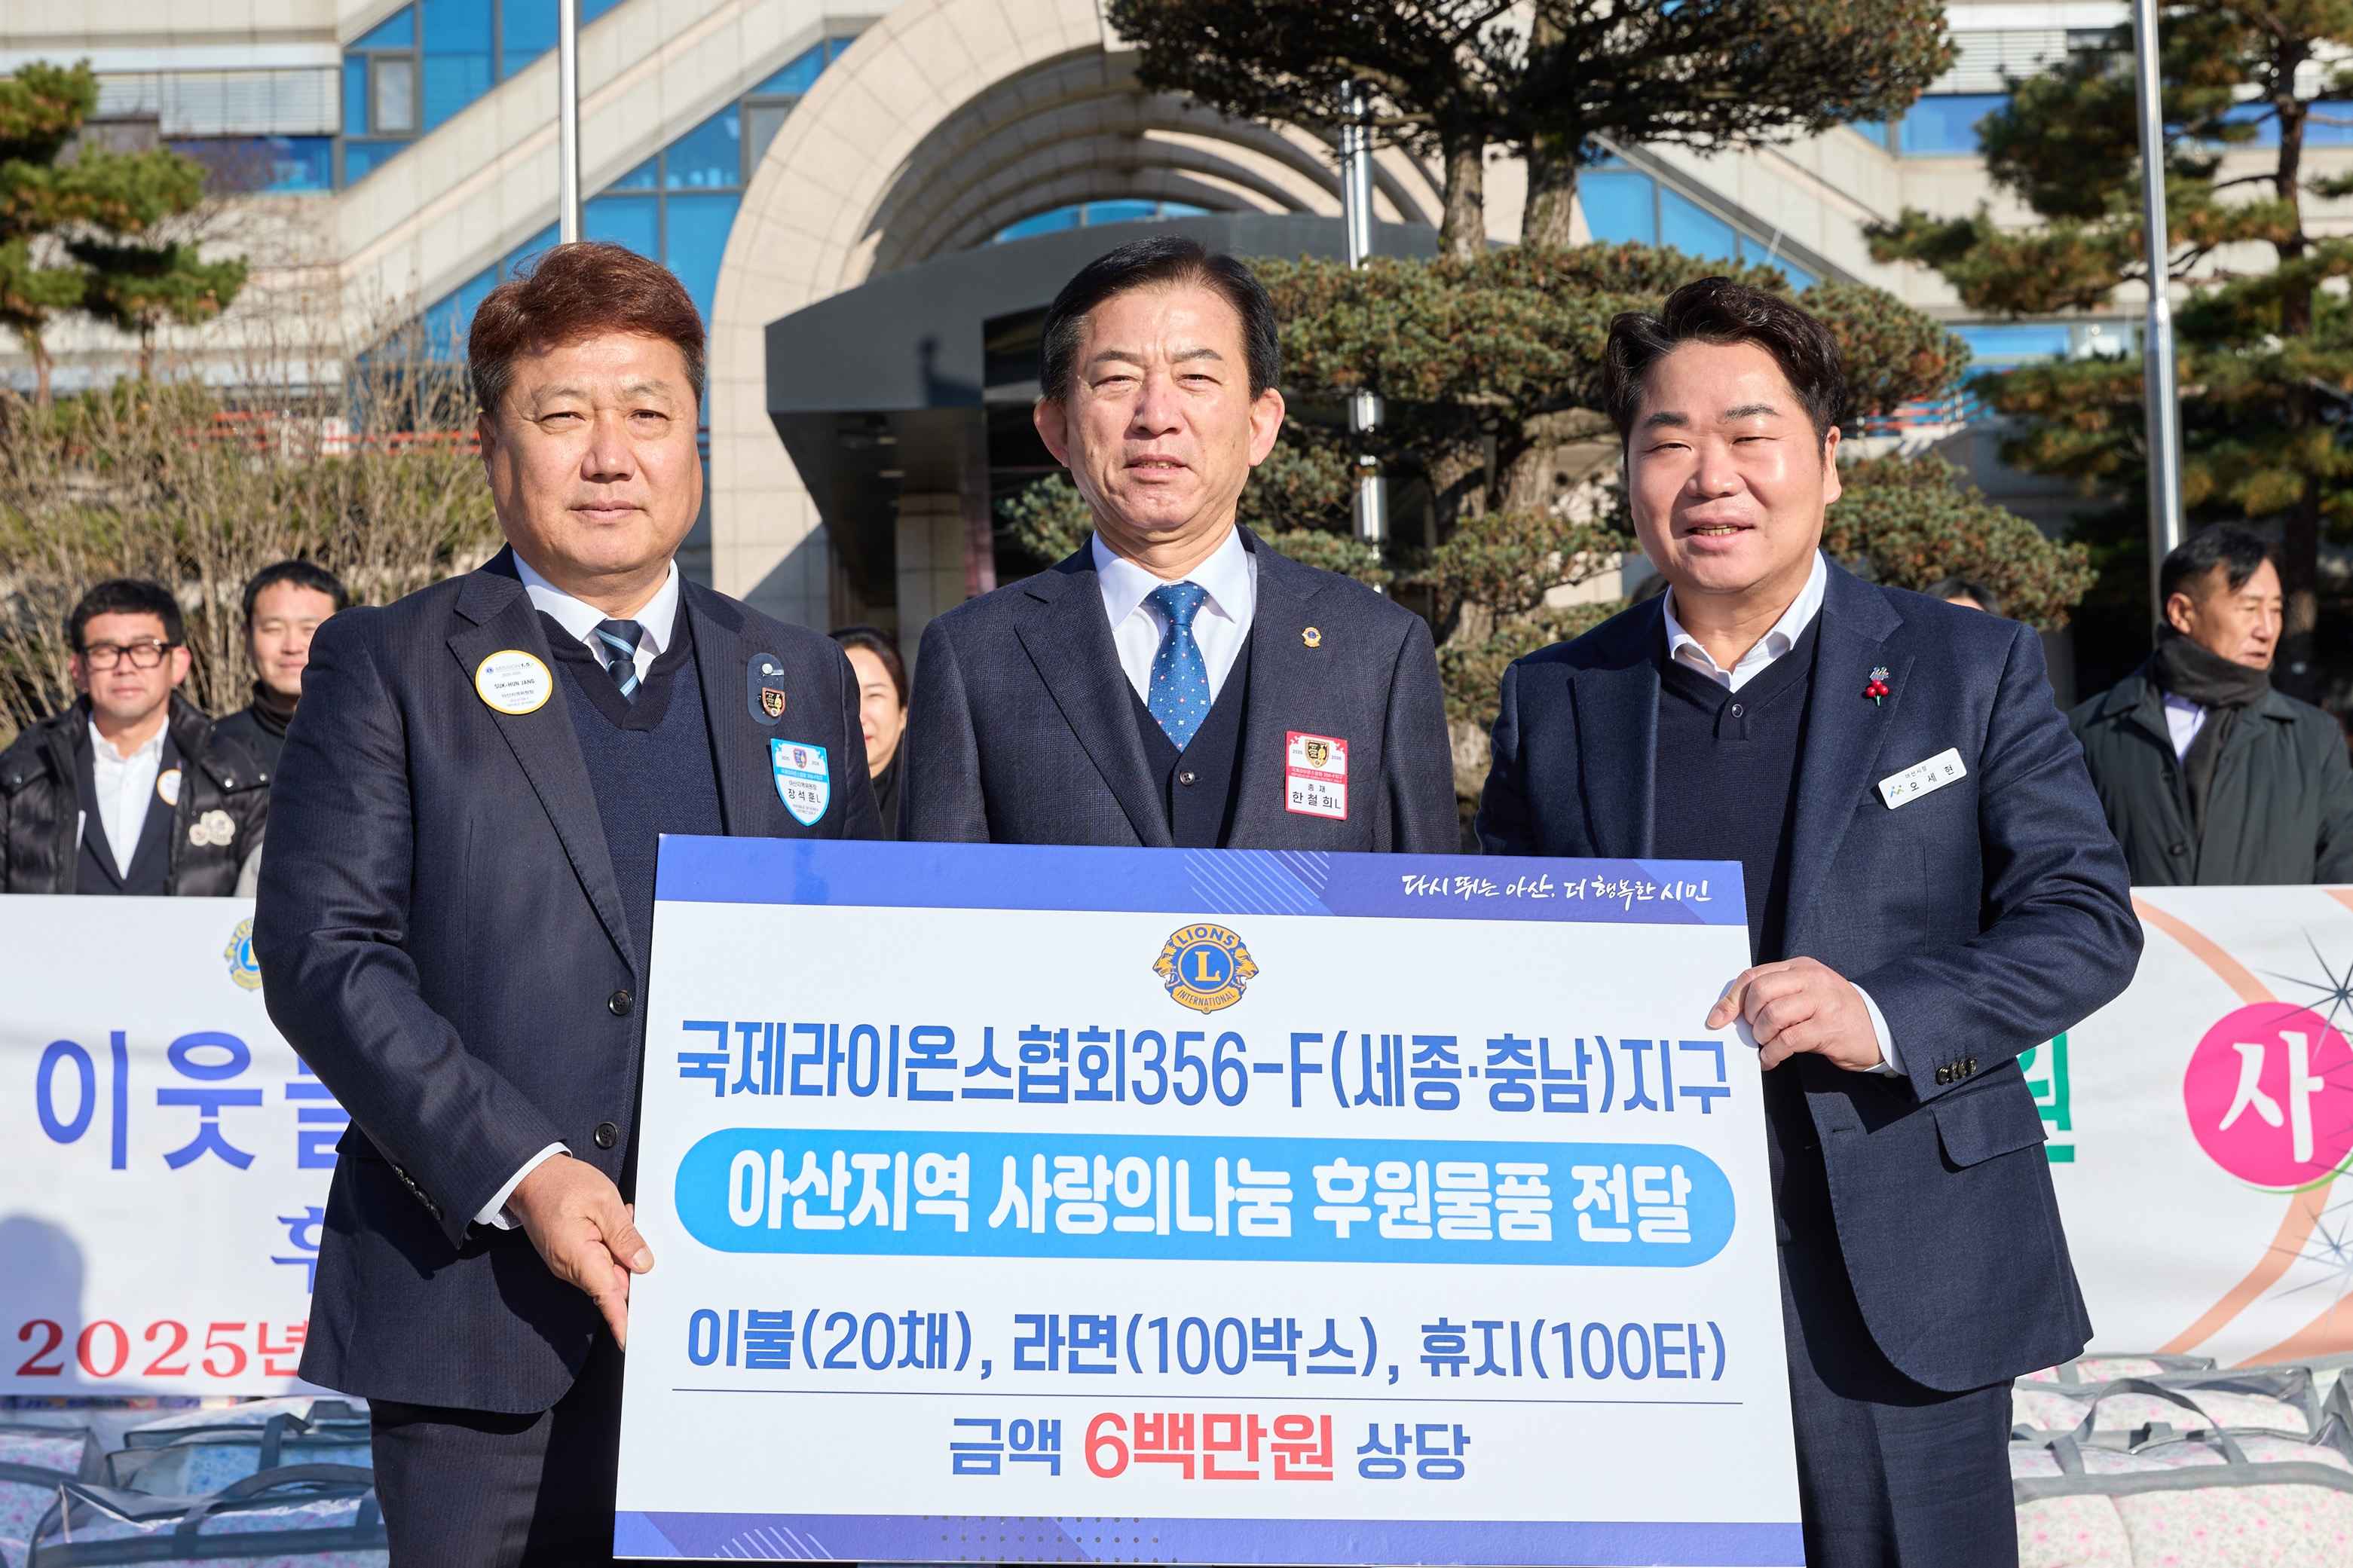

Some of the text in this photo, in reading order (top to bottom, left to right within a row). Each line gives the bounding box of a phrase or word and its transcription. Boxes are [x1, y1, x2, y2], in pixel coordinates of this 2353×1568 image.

[1402, 875, 1447, 896] 다시
[1455, 876, 1500, 900] 뛰는
[1564, 879, 1586, 900] 더
[1591, 875, 1657, 911] 행복한
[1660, 880, 1712, 903] 시민
[1176, 927, 1235, 946] LIONS
[1195, 951, 1221, 982] L
[1176, 989, 1236, 1007] INTERNATIONAL
[728, 1148, 1693, 1244] 아산지역 사랑의나눔 후원물품 전달
[687, 1308, 1727, 1386] 이불(20채), 라면(100박스), 휴지(100타)
[950, 1412, 1471, 1481] 금액 6백만원 상당
